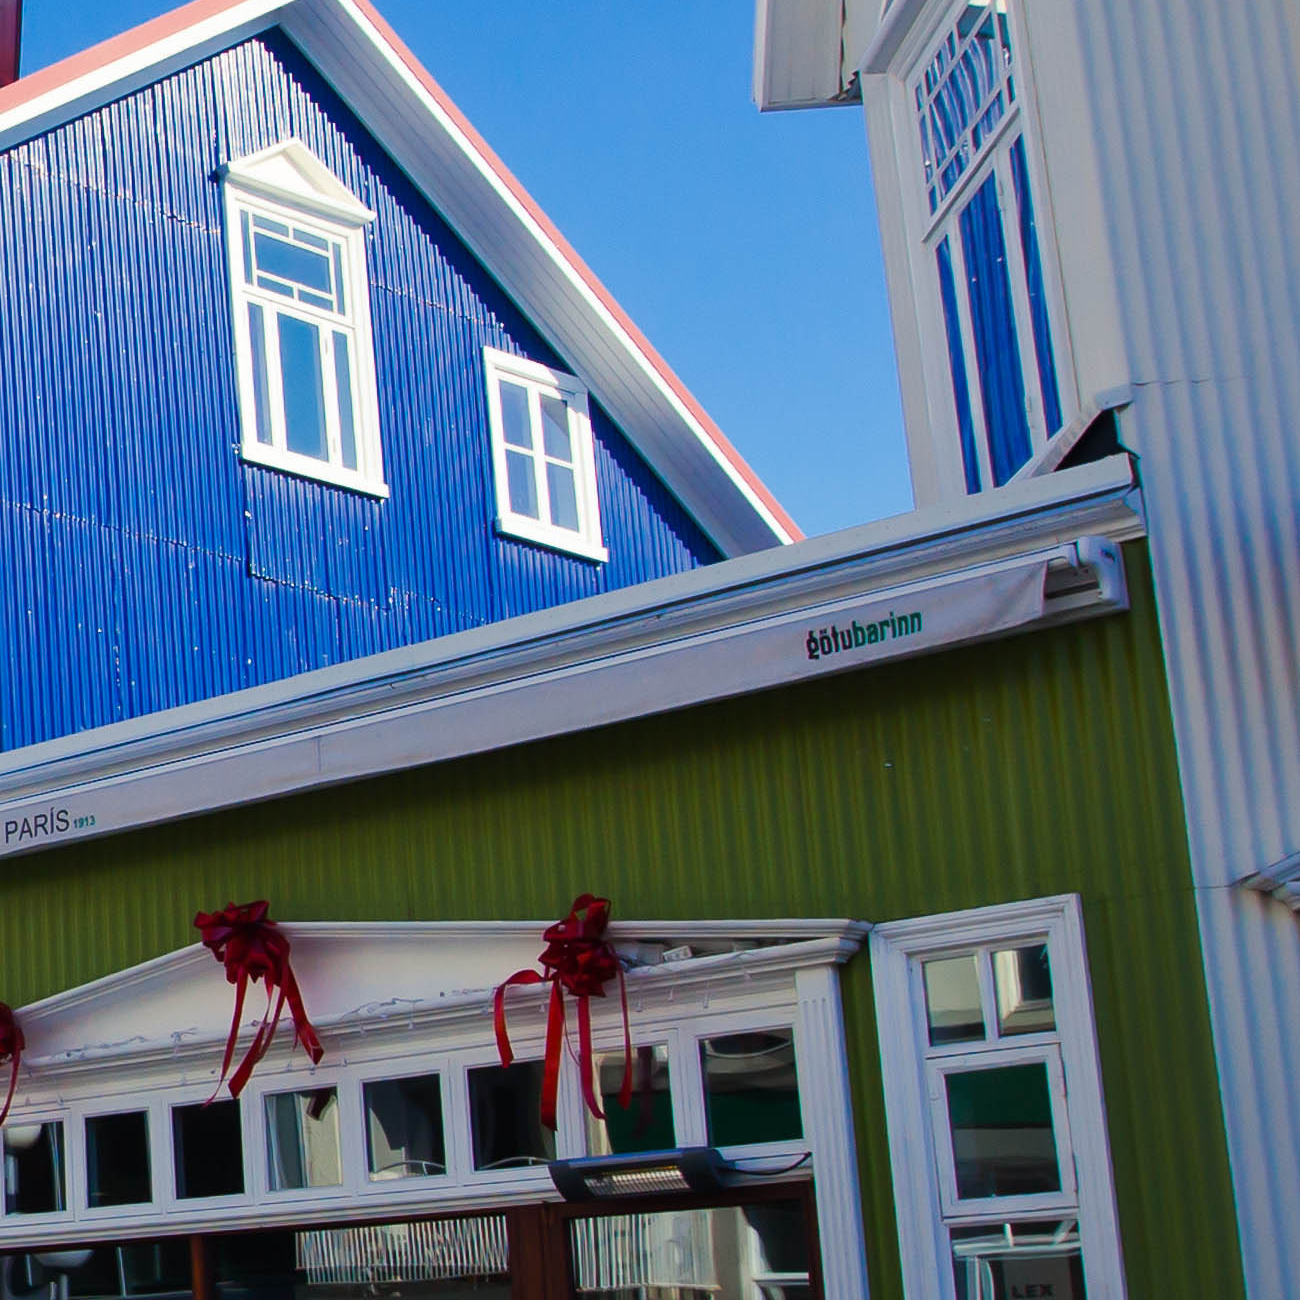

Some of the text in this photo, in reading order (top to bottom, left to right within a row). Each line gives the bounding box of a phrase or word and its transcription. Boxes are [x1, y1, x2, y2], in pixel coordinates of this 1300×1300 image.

[805, 611, 924, 660] götubarinn
[4, 806, 70, 845] PARÍS
[73, 815, 96, 829] 1913
